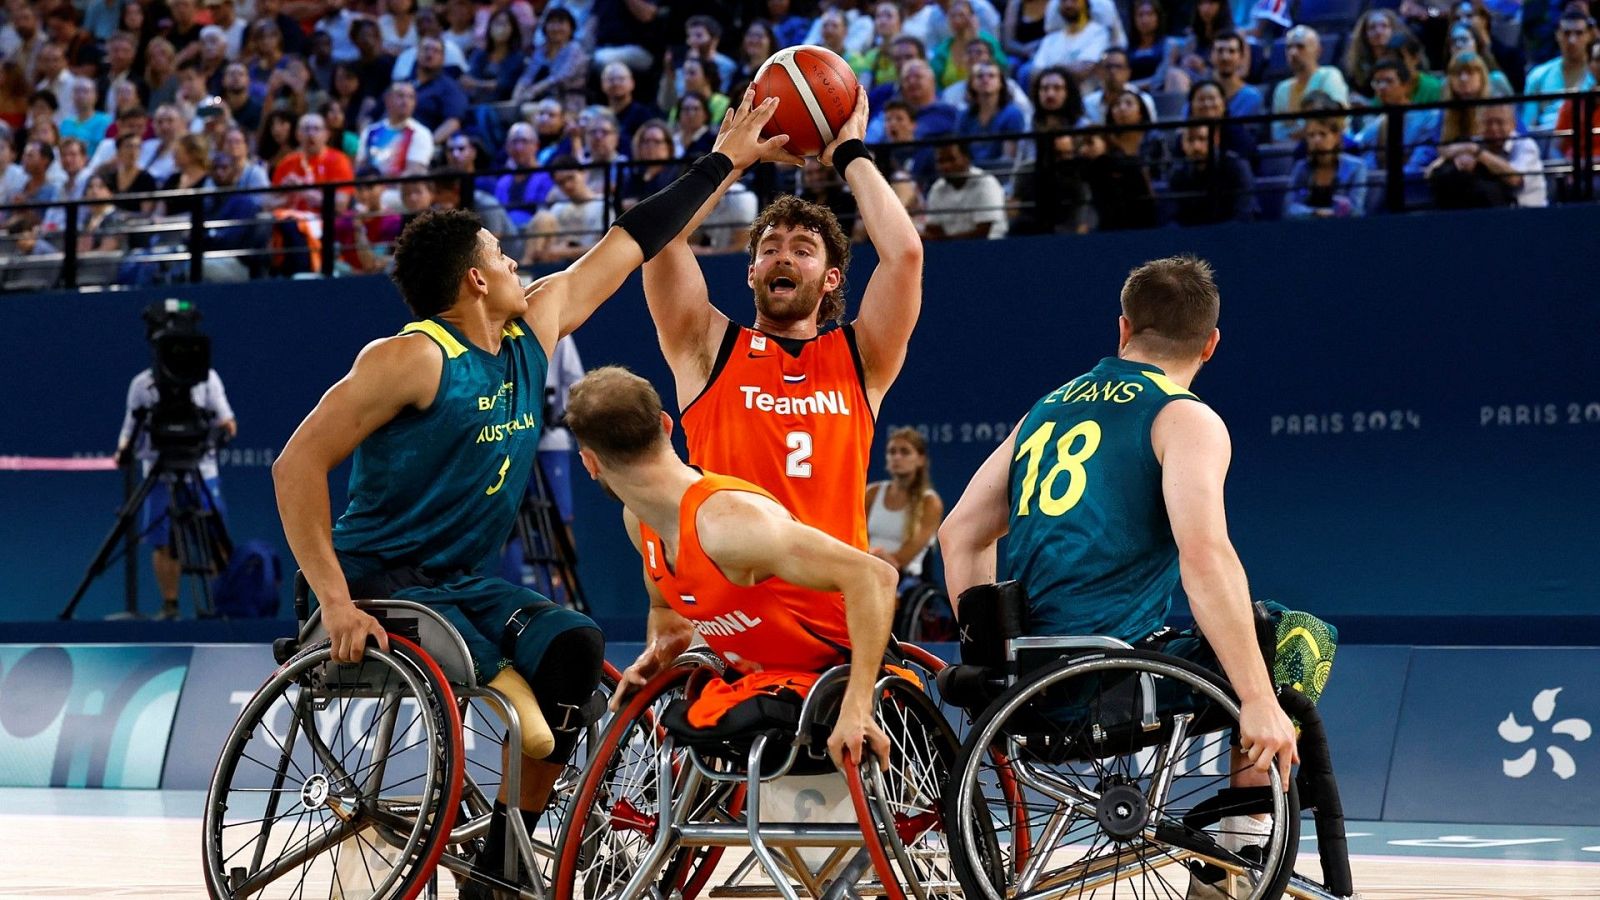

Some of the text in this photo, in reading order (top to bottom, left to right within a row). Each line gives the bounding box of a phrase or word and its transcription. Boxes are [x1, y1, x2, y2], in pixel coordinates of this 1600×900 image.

[739, 385, 850, 416] TeamNL
[1043, 379, 1144, 404] EVANS
[1270, 409, 1420, 435] PARIS 2024
[1480, 404, 1557, 426] PARIS
[886, 421, 1015, 444] PRIS 202
[219, 448, 274, 467] PARIS
[785, 431, 813, 479] 2
[1015, 420, 1102, 516] 18
